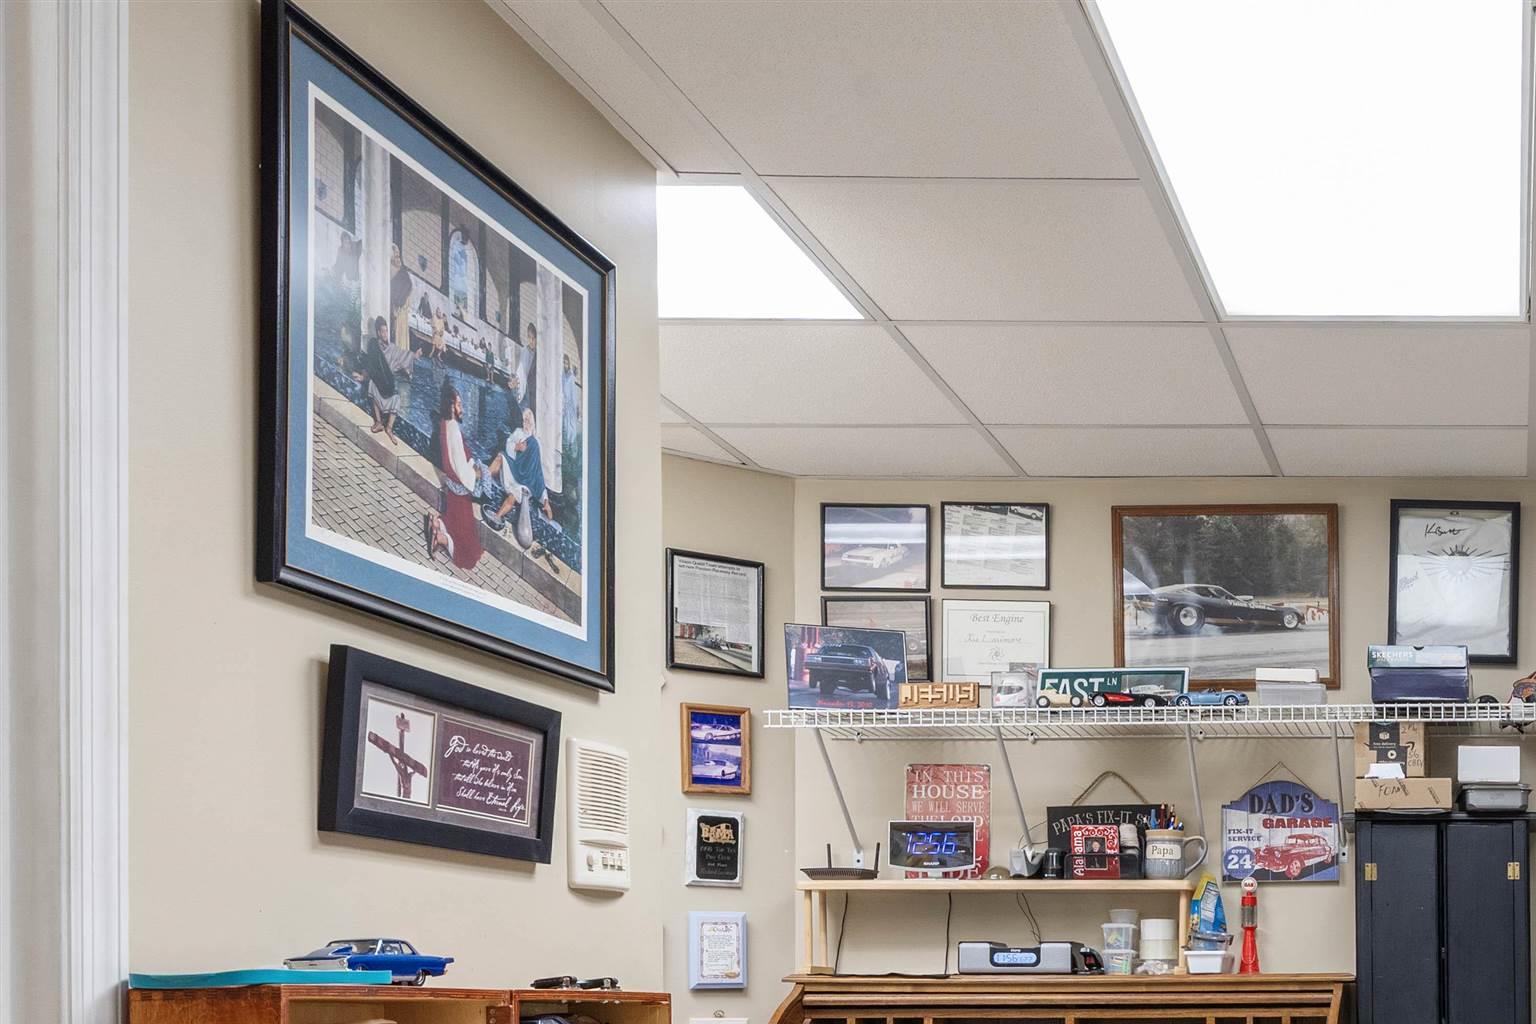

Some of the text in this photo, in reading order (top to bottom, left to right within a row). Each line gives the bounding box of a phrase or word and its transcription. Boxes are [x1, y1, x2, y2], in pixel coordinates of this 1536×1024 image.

[970, 614, 1024, 625] Best Engine
[1371, 651, 1413, 659] SKECHERS
[1107, 677, 1118, 686] LN
[915, 770, 984, 783] IN THIS
[912, 784, 985, 799] HOUSE
[912, 801, 985, 813] WE WILL SERVE
[1249, 792, 1314, 814] DAD'S
[1097, 810, 1132, 824] FIX-IT
[1262, 817, 1332, 829] GARAGE
[1151, 846, 1174, 857] Papa
[1227, 855, 1252, 869] 24
